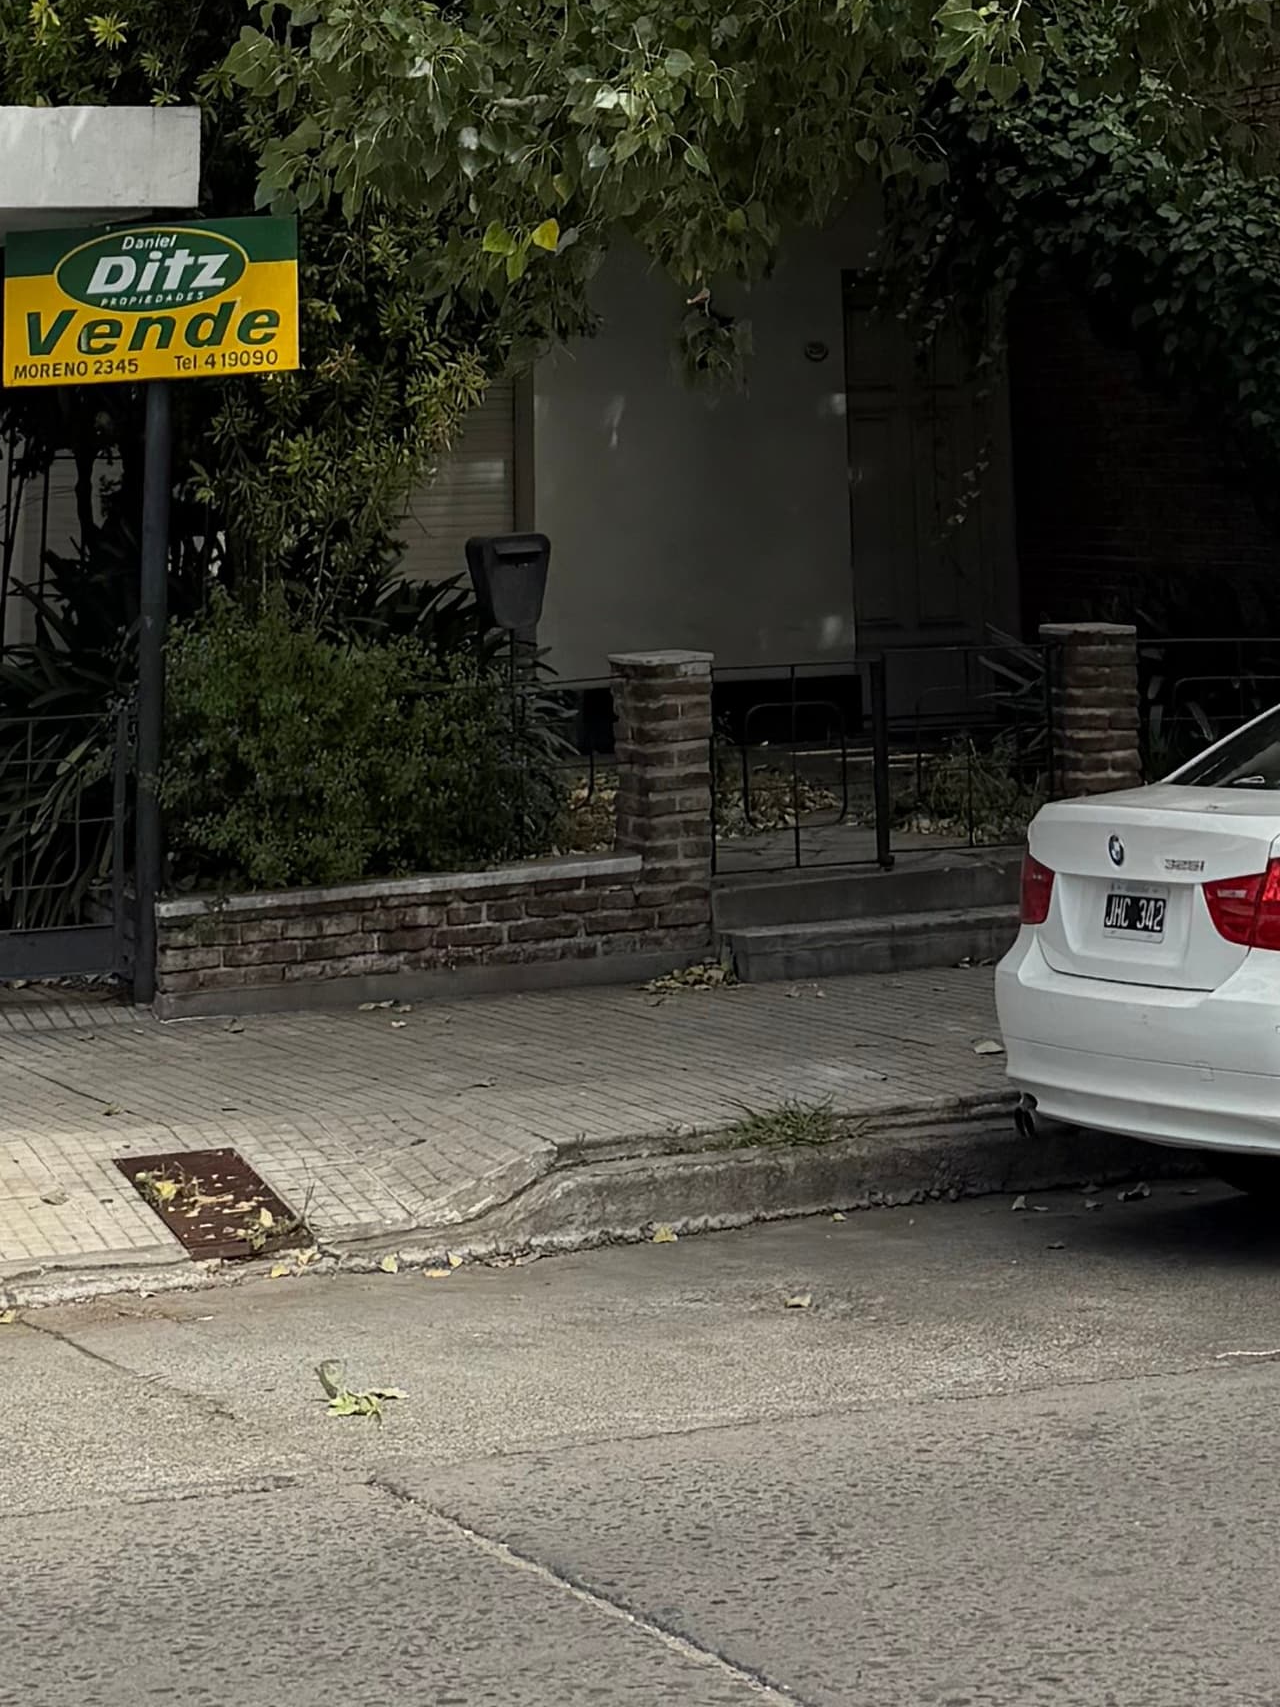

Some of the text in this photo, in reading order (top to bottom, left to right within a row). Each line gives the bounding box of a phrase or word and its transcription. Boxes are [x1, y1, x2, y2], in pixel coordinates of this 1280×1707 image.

[122, 235, 177, 250] Daniel
[86, 249, 229, 294] Ditz
[101, 292, 204, 306] PROPIEDADES
[27, 300, 280, 356] Vende
[14, 359, 138, 379] MORENO 2345
[1106, 896, 1164, 930] JHC 342
